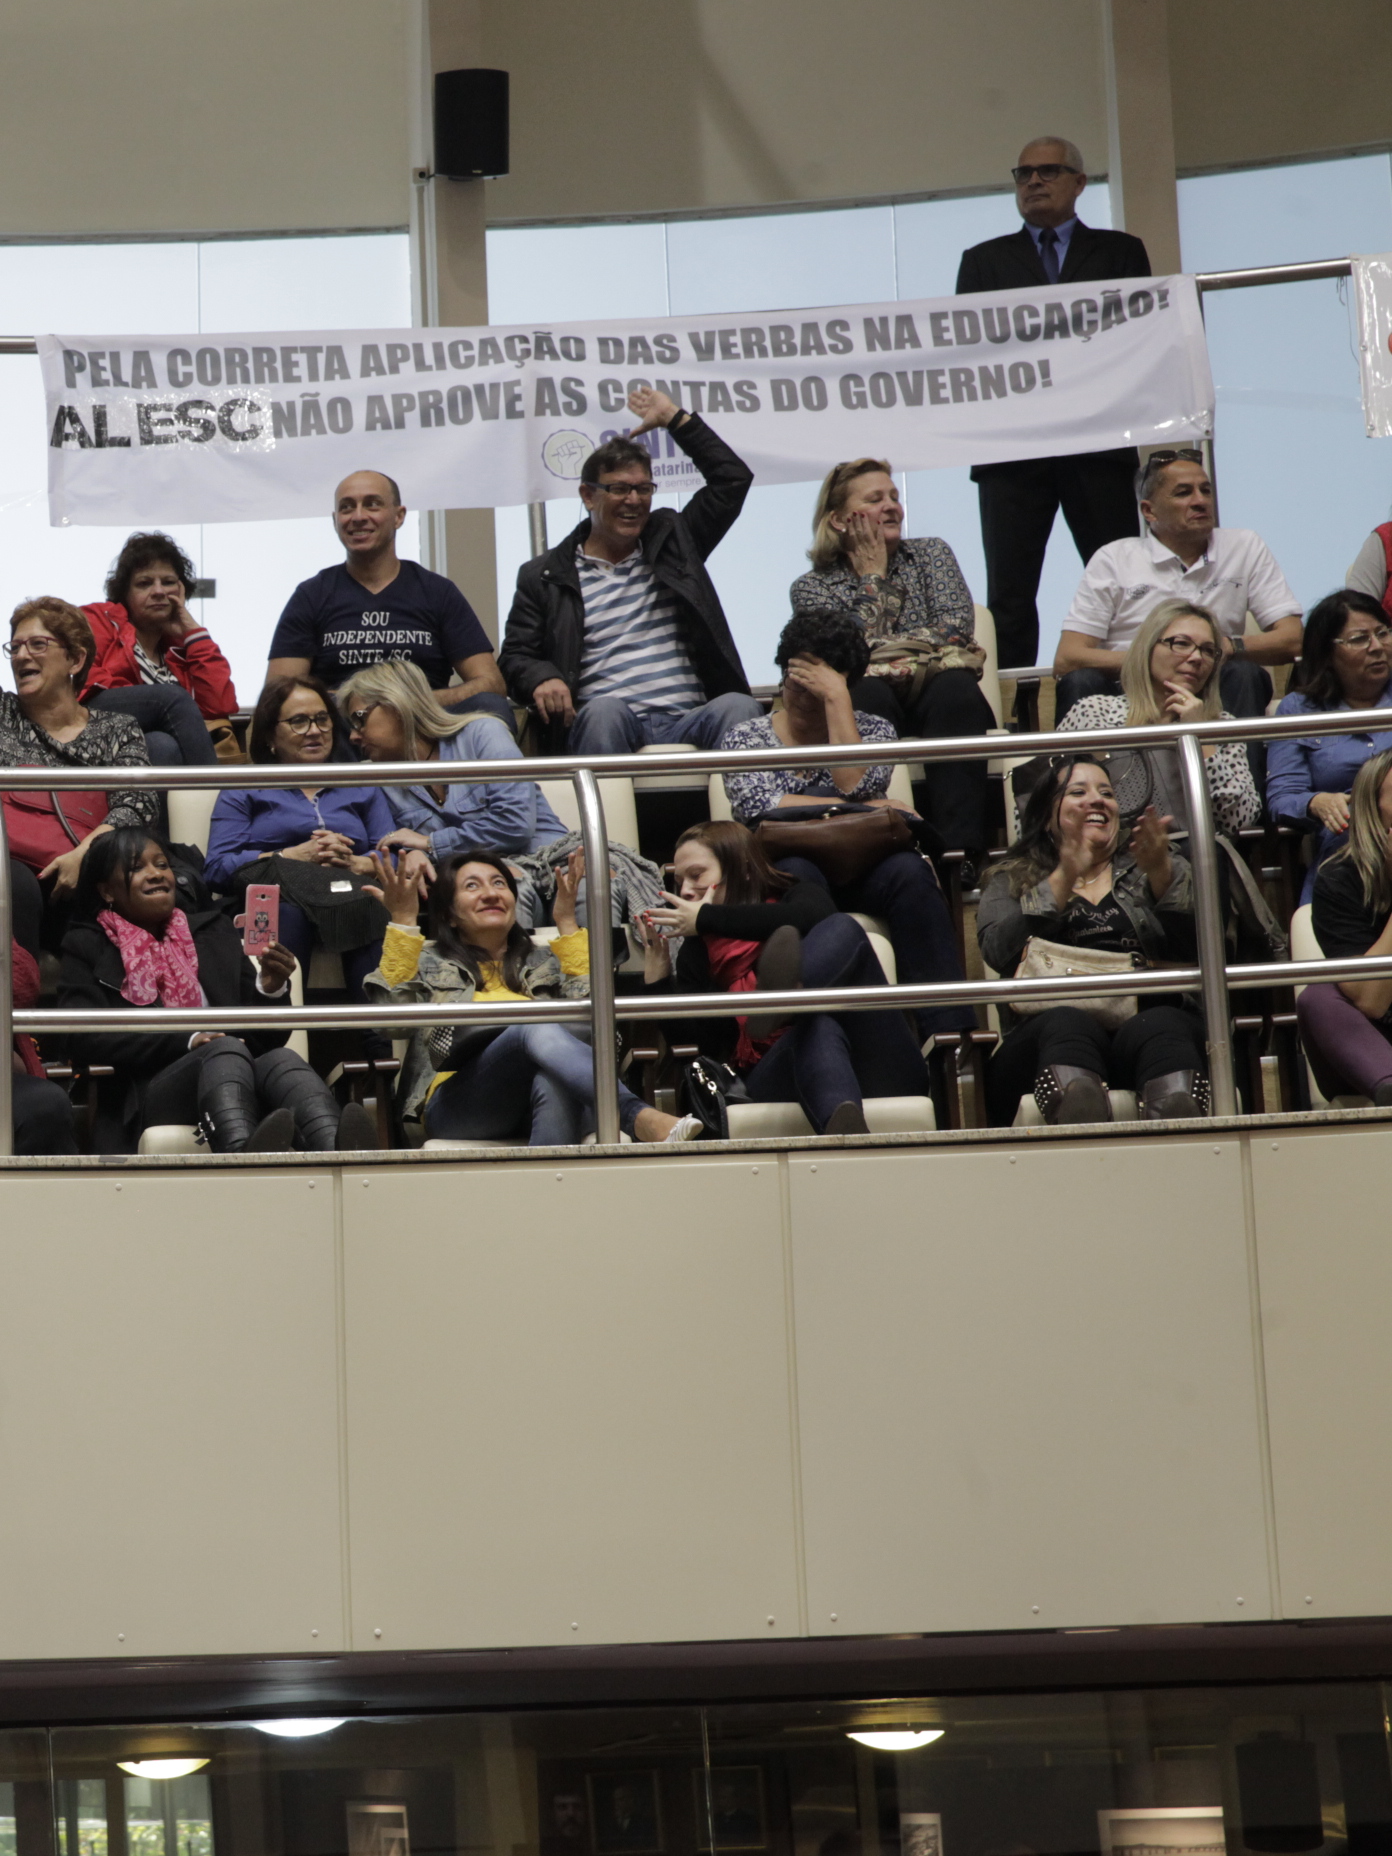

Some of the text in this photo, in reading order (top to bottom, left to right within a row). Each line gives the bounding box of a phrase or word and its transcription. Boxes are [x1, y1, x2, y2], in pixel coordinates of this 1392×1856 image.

[62, 286, 1171, 390] PELA CORRETA APLICAÇÃO DAS VERBAS NA EDUCAÇÃO!
[49, 397, 265, 450] ALESC
[272, 392, 355, 440] NÃO
[364, 381, 525, 431] APROVE
[533, 376, 589, 418] AS
[771, 374, 828, 412] DO
[839, 358, 1053, 409] GOVERNO!
[361, 611, 391, 627] SOU
[322, 629, 433, 647] INDEPENDENTE
[338, 649, 384, 665] SINTE
